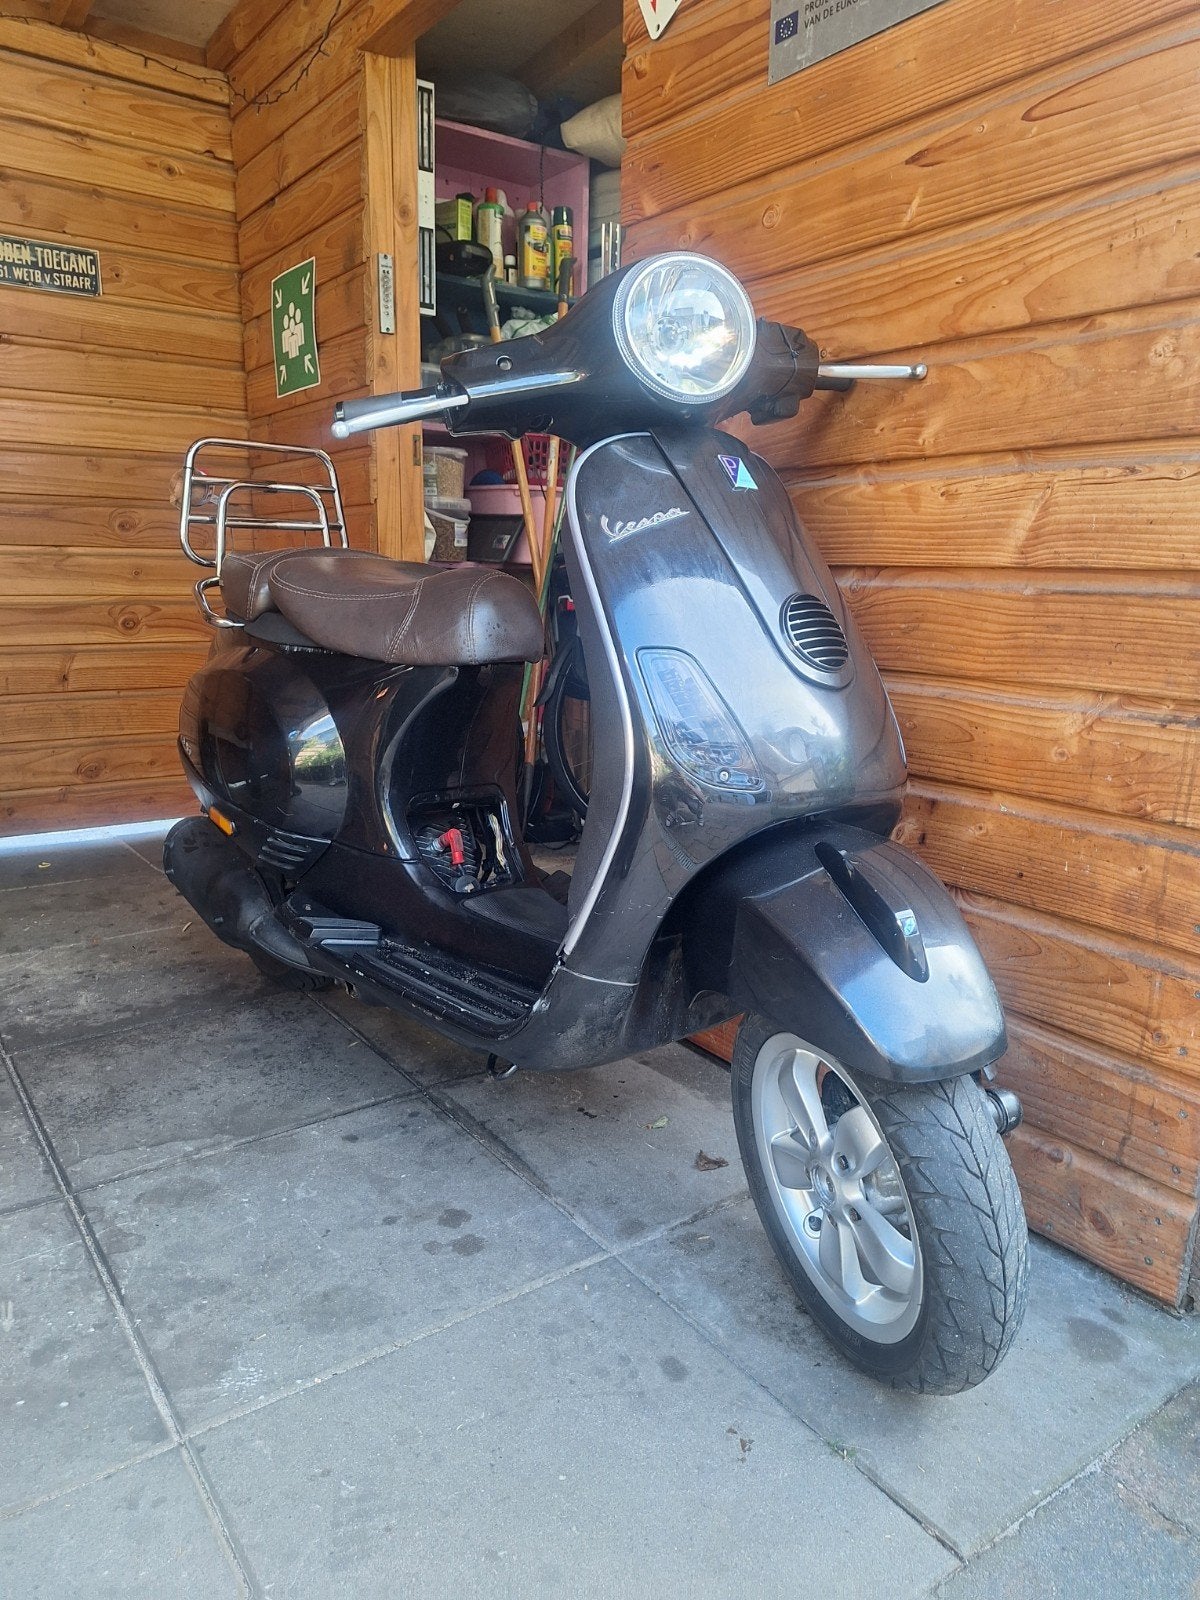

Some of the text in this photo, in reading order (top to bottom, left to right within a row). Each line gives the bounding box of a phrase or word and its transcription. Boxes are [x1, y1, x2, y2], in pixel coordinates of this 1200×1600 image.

[804, 13, 821, 29] VAN
[823, 6, 834, 19] DE
[34, 246, 96, 276] TOEGANG
[600, 508, 690, 544] Vespa
